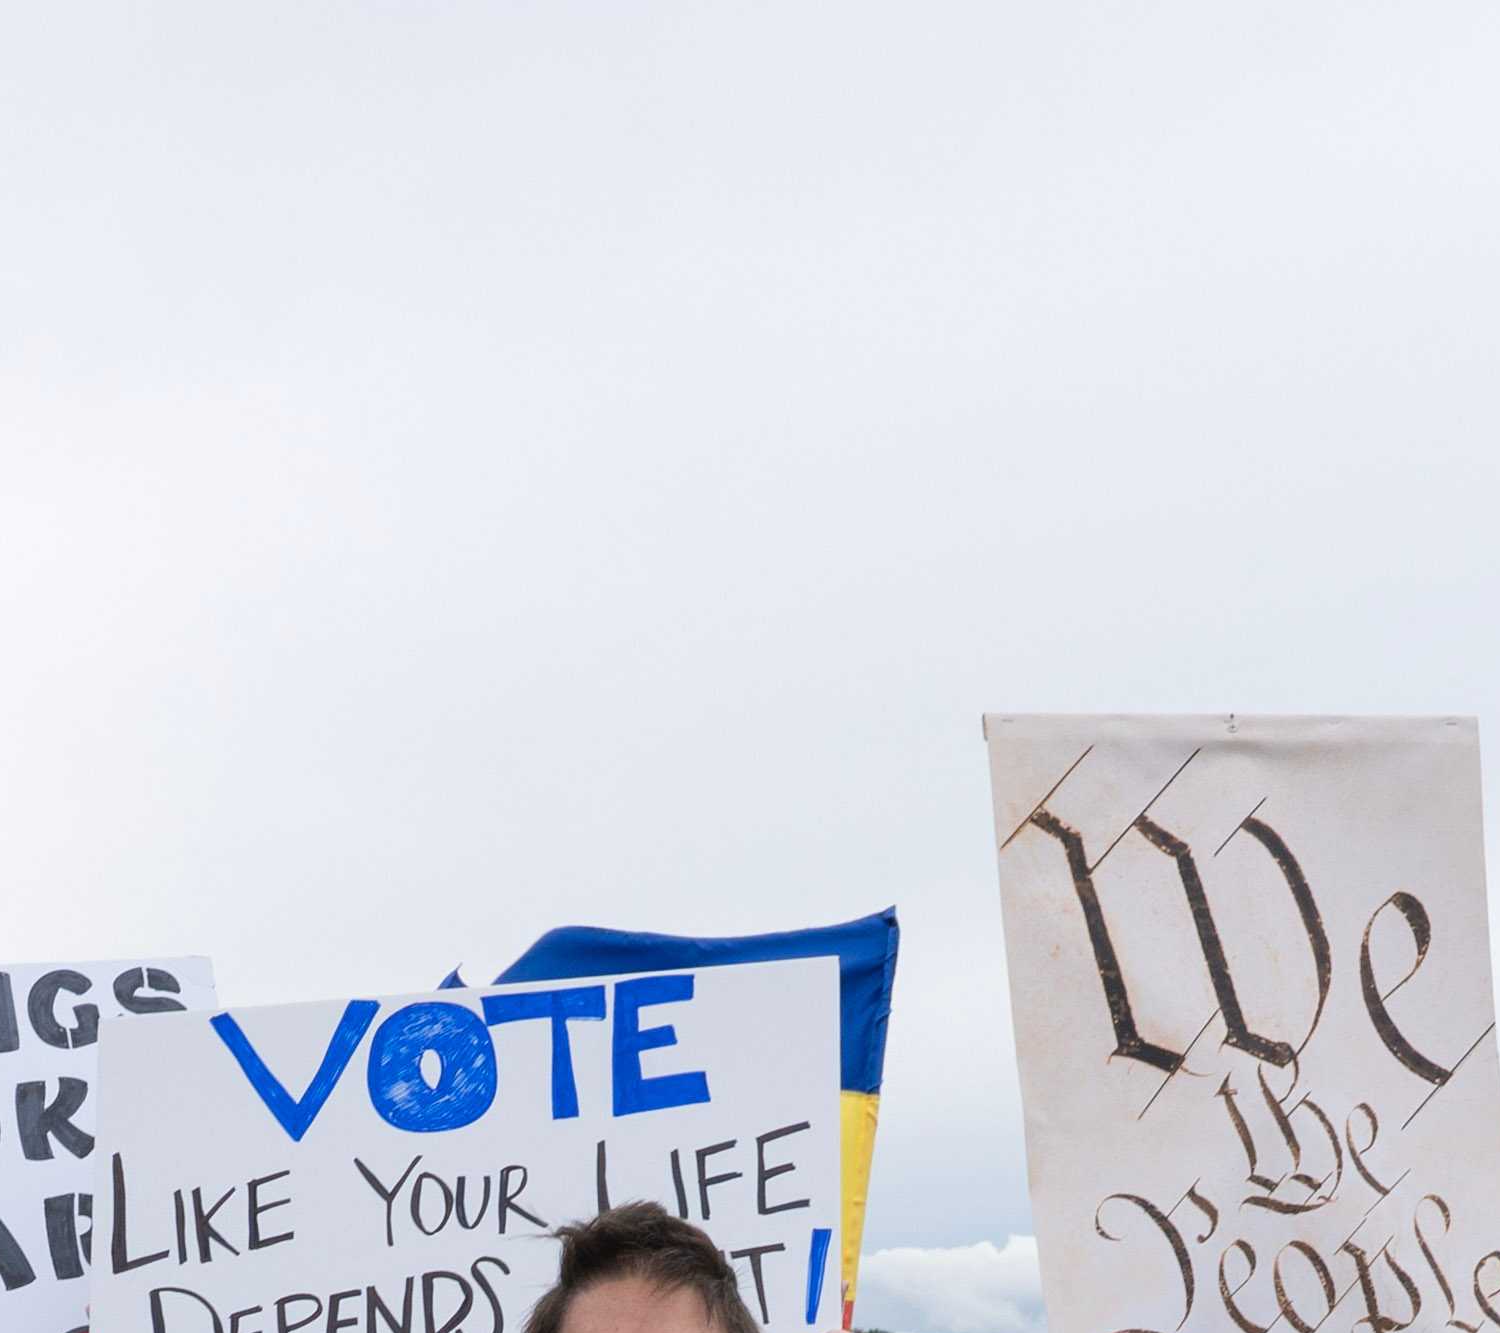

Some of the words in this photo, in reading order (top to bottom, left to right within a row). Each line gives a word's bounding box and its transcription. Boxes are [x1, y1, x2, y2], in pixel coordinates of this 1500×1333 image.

[1000, 746, 1496, 1128] We
[210, 974, 711, 1142] VOTE
[111, 1152, 295, 1273] LIKE
[355, 1154, 549, 1246] YOUR
[1216, 1063, 1410, 1214] the
